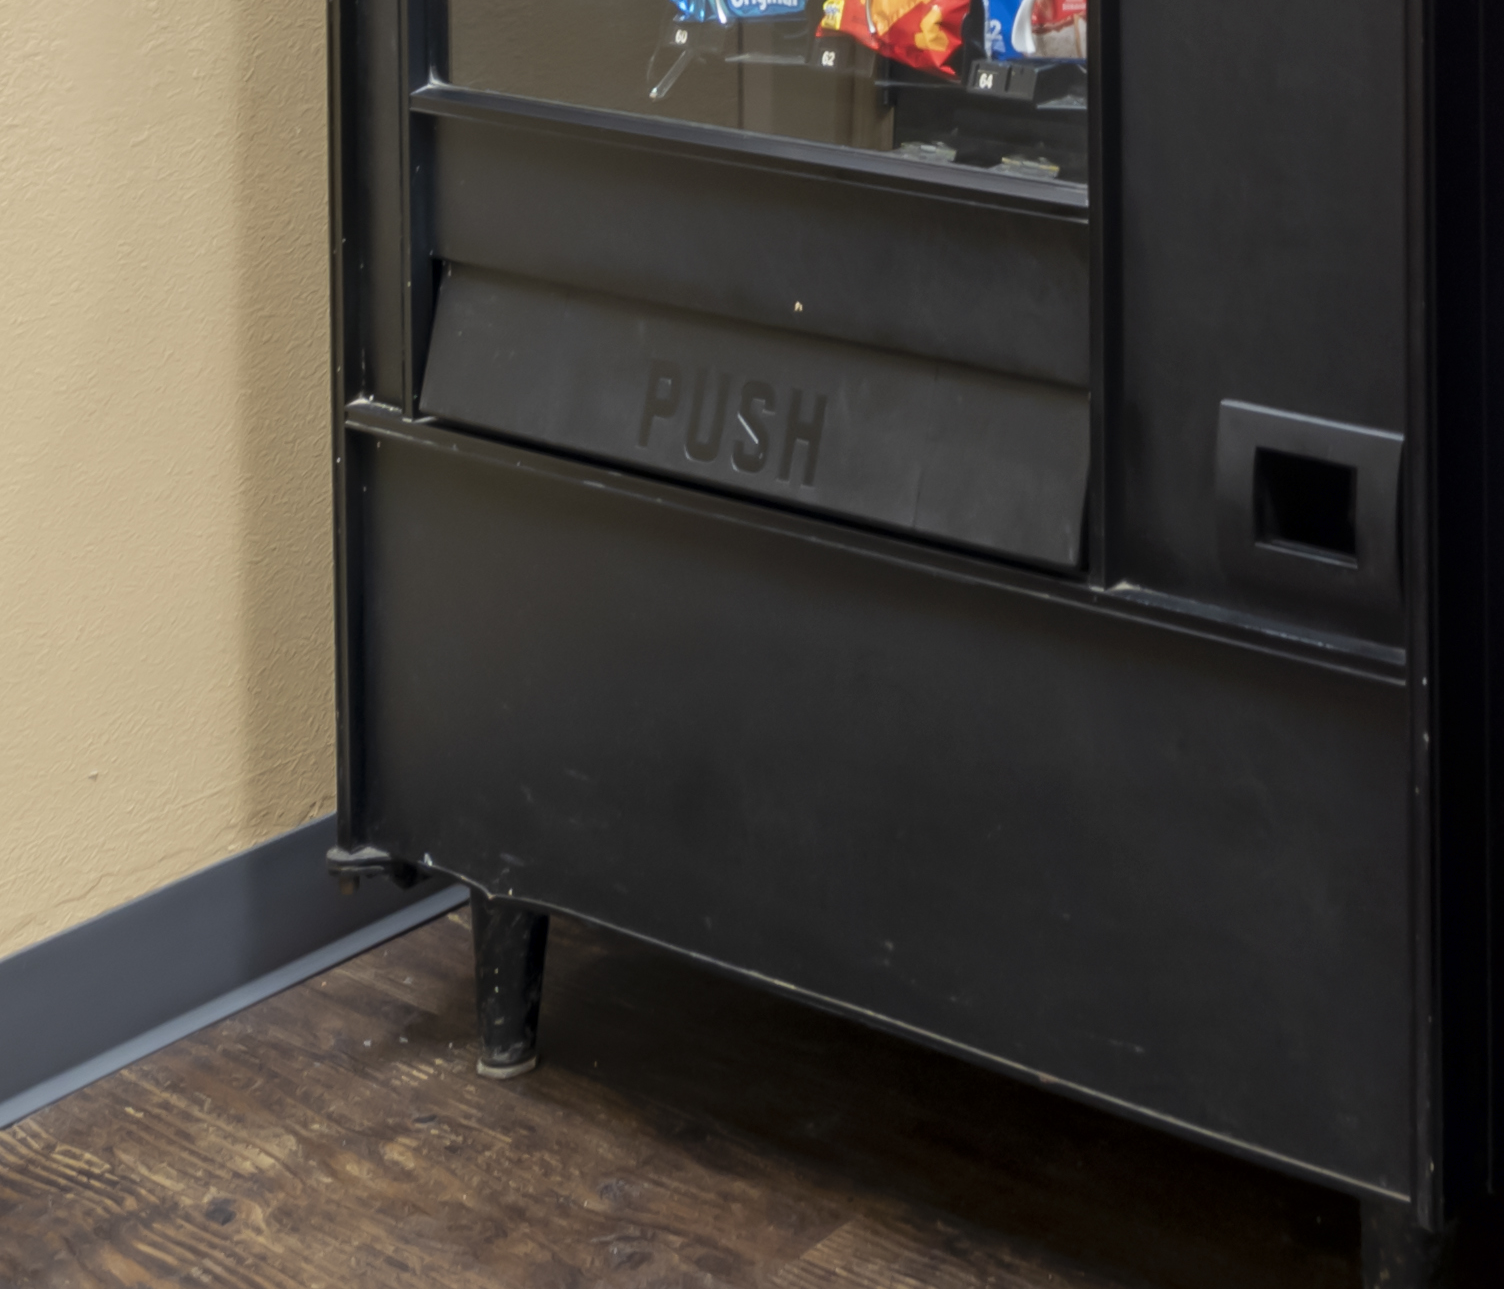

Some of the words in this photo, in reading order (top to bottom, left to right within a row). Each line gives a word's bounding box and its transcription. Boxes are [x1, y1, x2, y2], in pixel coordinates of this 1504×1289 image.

[674, 30, 688, 45] 60
[822, 51, 835, 67] 62
[978, 73, 993, 90] 64
[637, 357, 831, 490] PUSH
